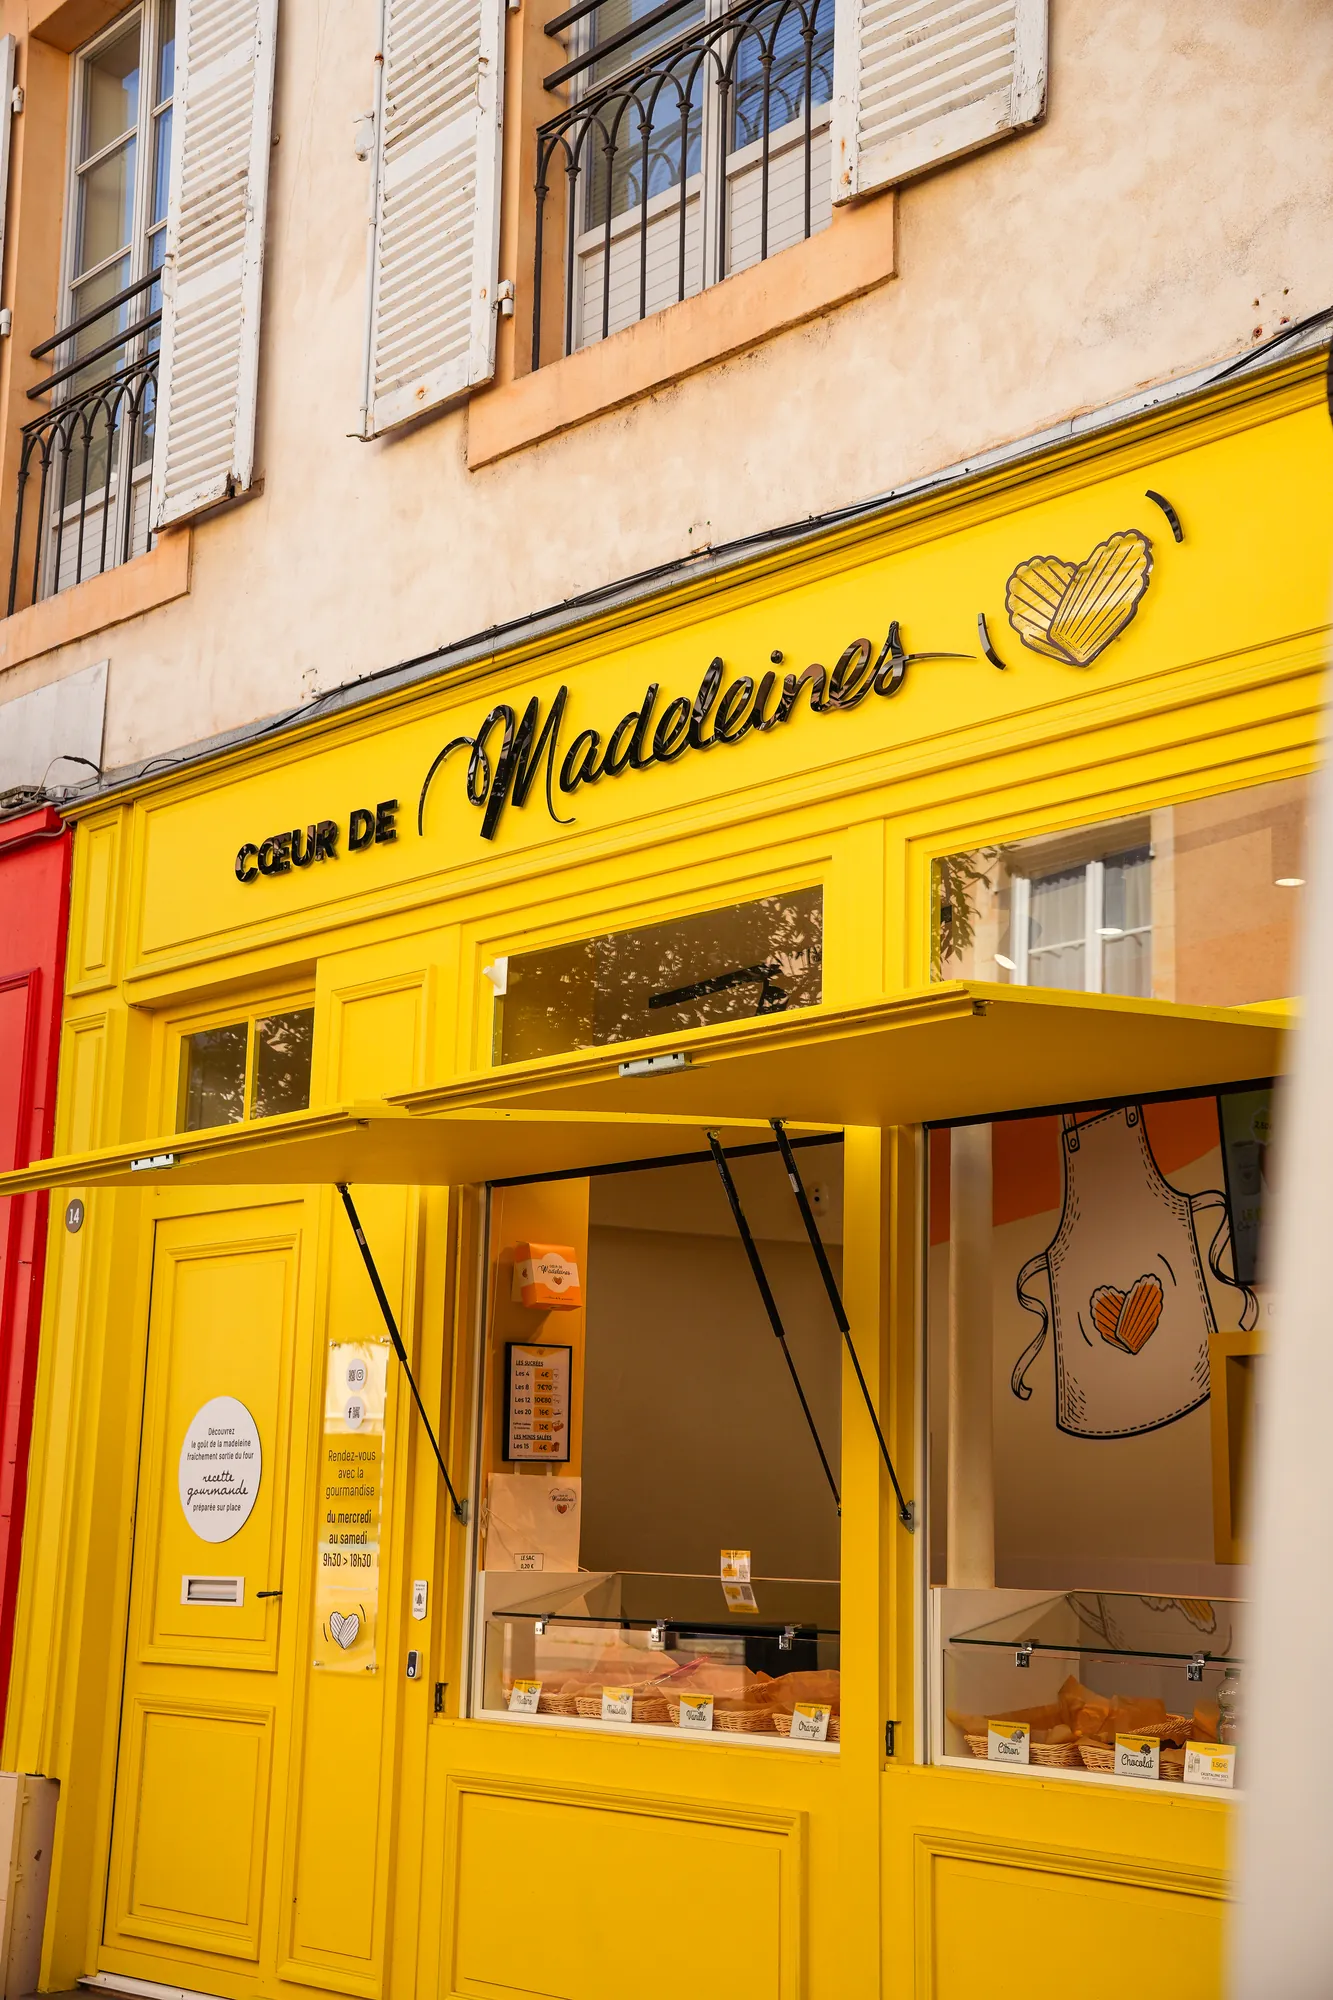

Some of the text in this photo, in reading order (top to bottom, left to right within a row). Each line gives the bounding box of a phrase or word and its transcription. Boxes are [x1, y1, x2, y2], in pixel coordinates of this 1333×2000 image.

[235, 620, 977, 883] CŒUR DE Madeleines
[69, 1208, 80, 1224] 14
[208, 1427, 235, 1435] Découvrez
[191, 1440, 196, 1449] le
[197, 1440, 208, 1450] goût
[210, 1440, 216, 1448] de
[223, 1439, 251, 1448] madeleine
[219, 1452, 234, 1460] sortie
[243, 1451, 254, 1460] four
[328, 1450, 376, 1462] Rendez-vous
[202, 1470, 234, 1483] recette
[338, 1467, 364, 1479] avec la
[187, 1479, 248, 1505] gourmande
[326, 1483, 374, 1500] gourmandise
[193, 1502, 216, 1512] préparée
[226, 1502, 241, 1512] place
[327, 1509, 372, 1523] du mercredi
[329, 1531, 367, 1545] au samedi
[323, 1553, 341, 1567] 9h30
[350, 1553, 371, 1568] 18h30
[686, 1710, 706, 1721] Vanille
[799, 1721, 820, 1737] Orange
[998, 1741, 1020, 1755] Citron
[1121, 1753, 1154, 1768] Chocolat
